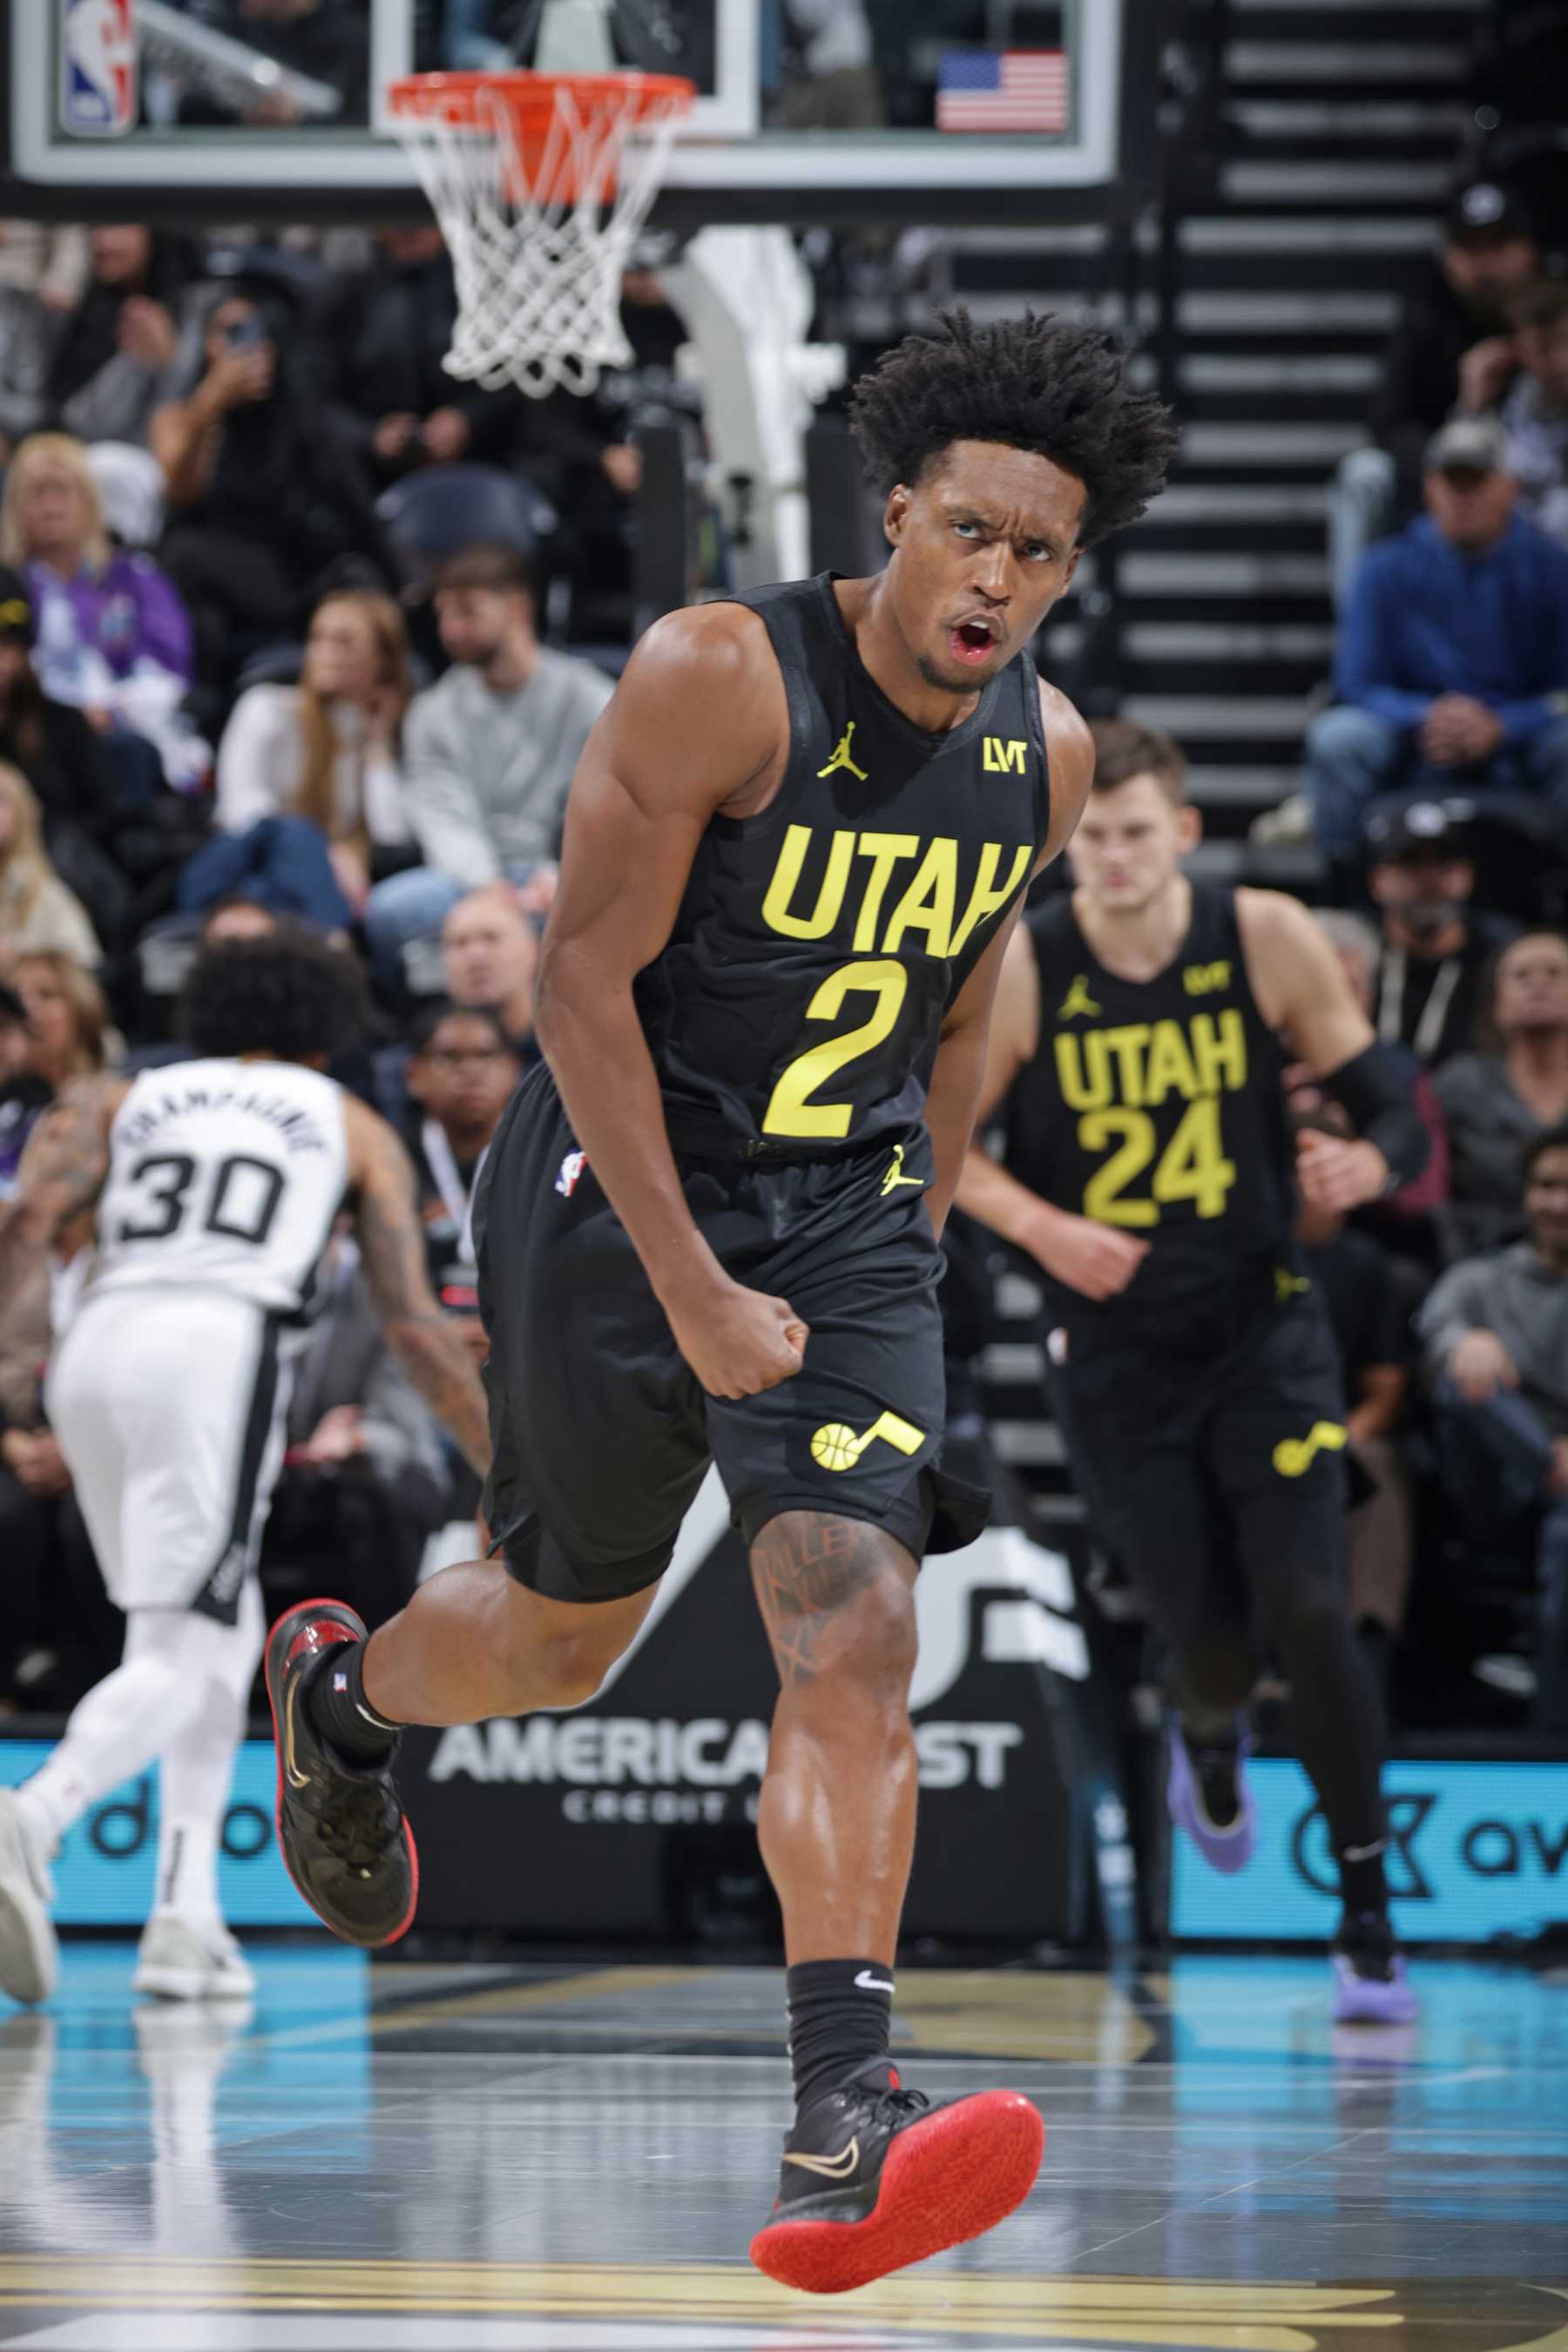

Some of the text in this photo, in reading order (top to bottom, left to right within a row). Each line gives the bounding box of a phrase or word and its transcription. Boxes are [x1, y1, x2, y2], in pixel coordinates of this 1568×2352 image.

[983, 736, 1028, 774] LVT
[761, 823, 1033, 958] UTAH
[761, 958, 909, 1139] 2
[1052, 1007, 1247, 1112] UTAH
[118, 1152, 286, 1244] 30
[1076, 1094, 1237, 1228] 24
[428, 1716, 766, 1785] AMERICA
[561, 1789, 727, 1824] CREDIT
